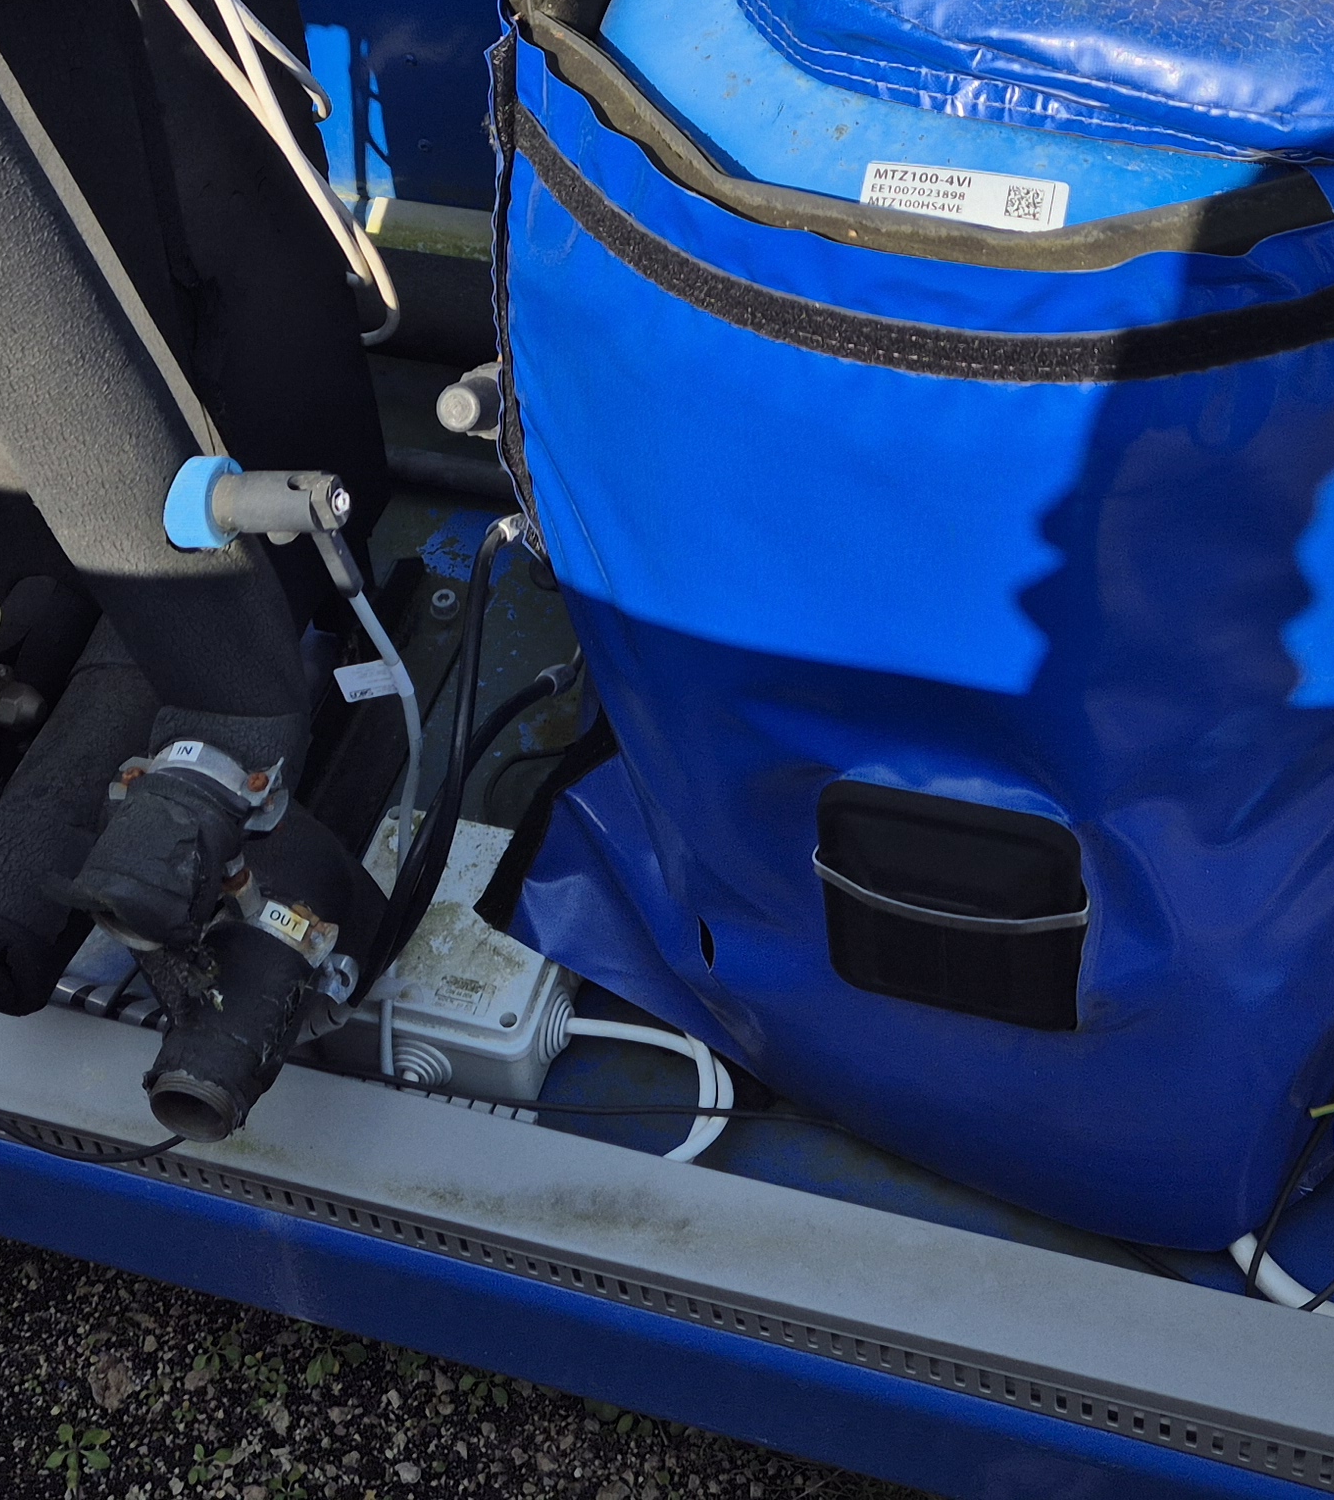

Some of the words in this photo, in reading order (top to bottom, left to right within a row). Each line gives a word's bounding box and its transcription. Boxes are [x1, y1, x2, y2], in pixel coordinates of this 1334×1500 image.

[873, 167, 972, 188] MTZ100-4VI
[870, 182, 966, 201] EE1007023898
[176, 745, 193, 756] IN
[269, 908, 302, 932] OUT
